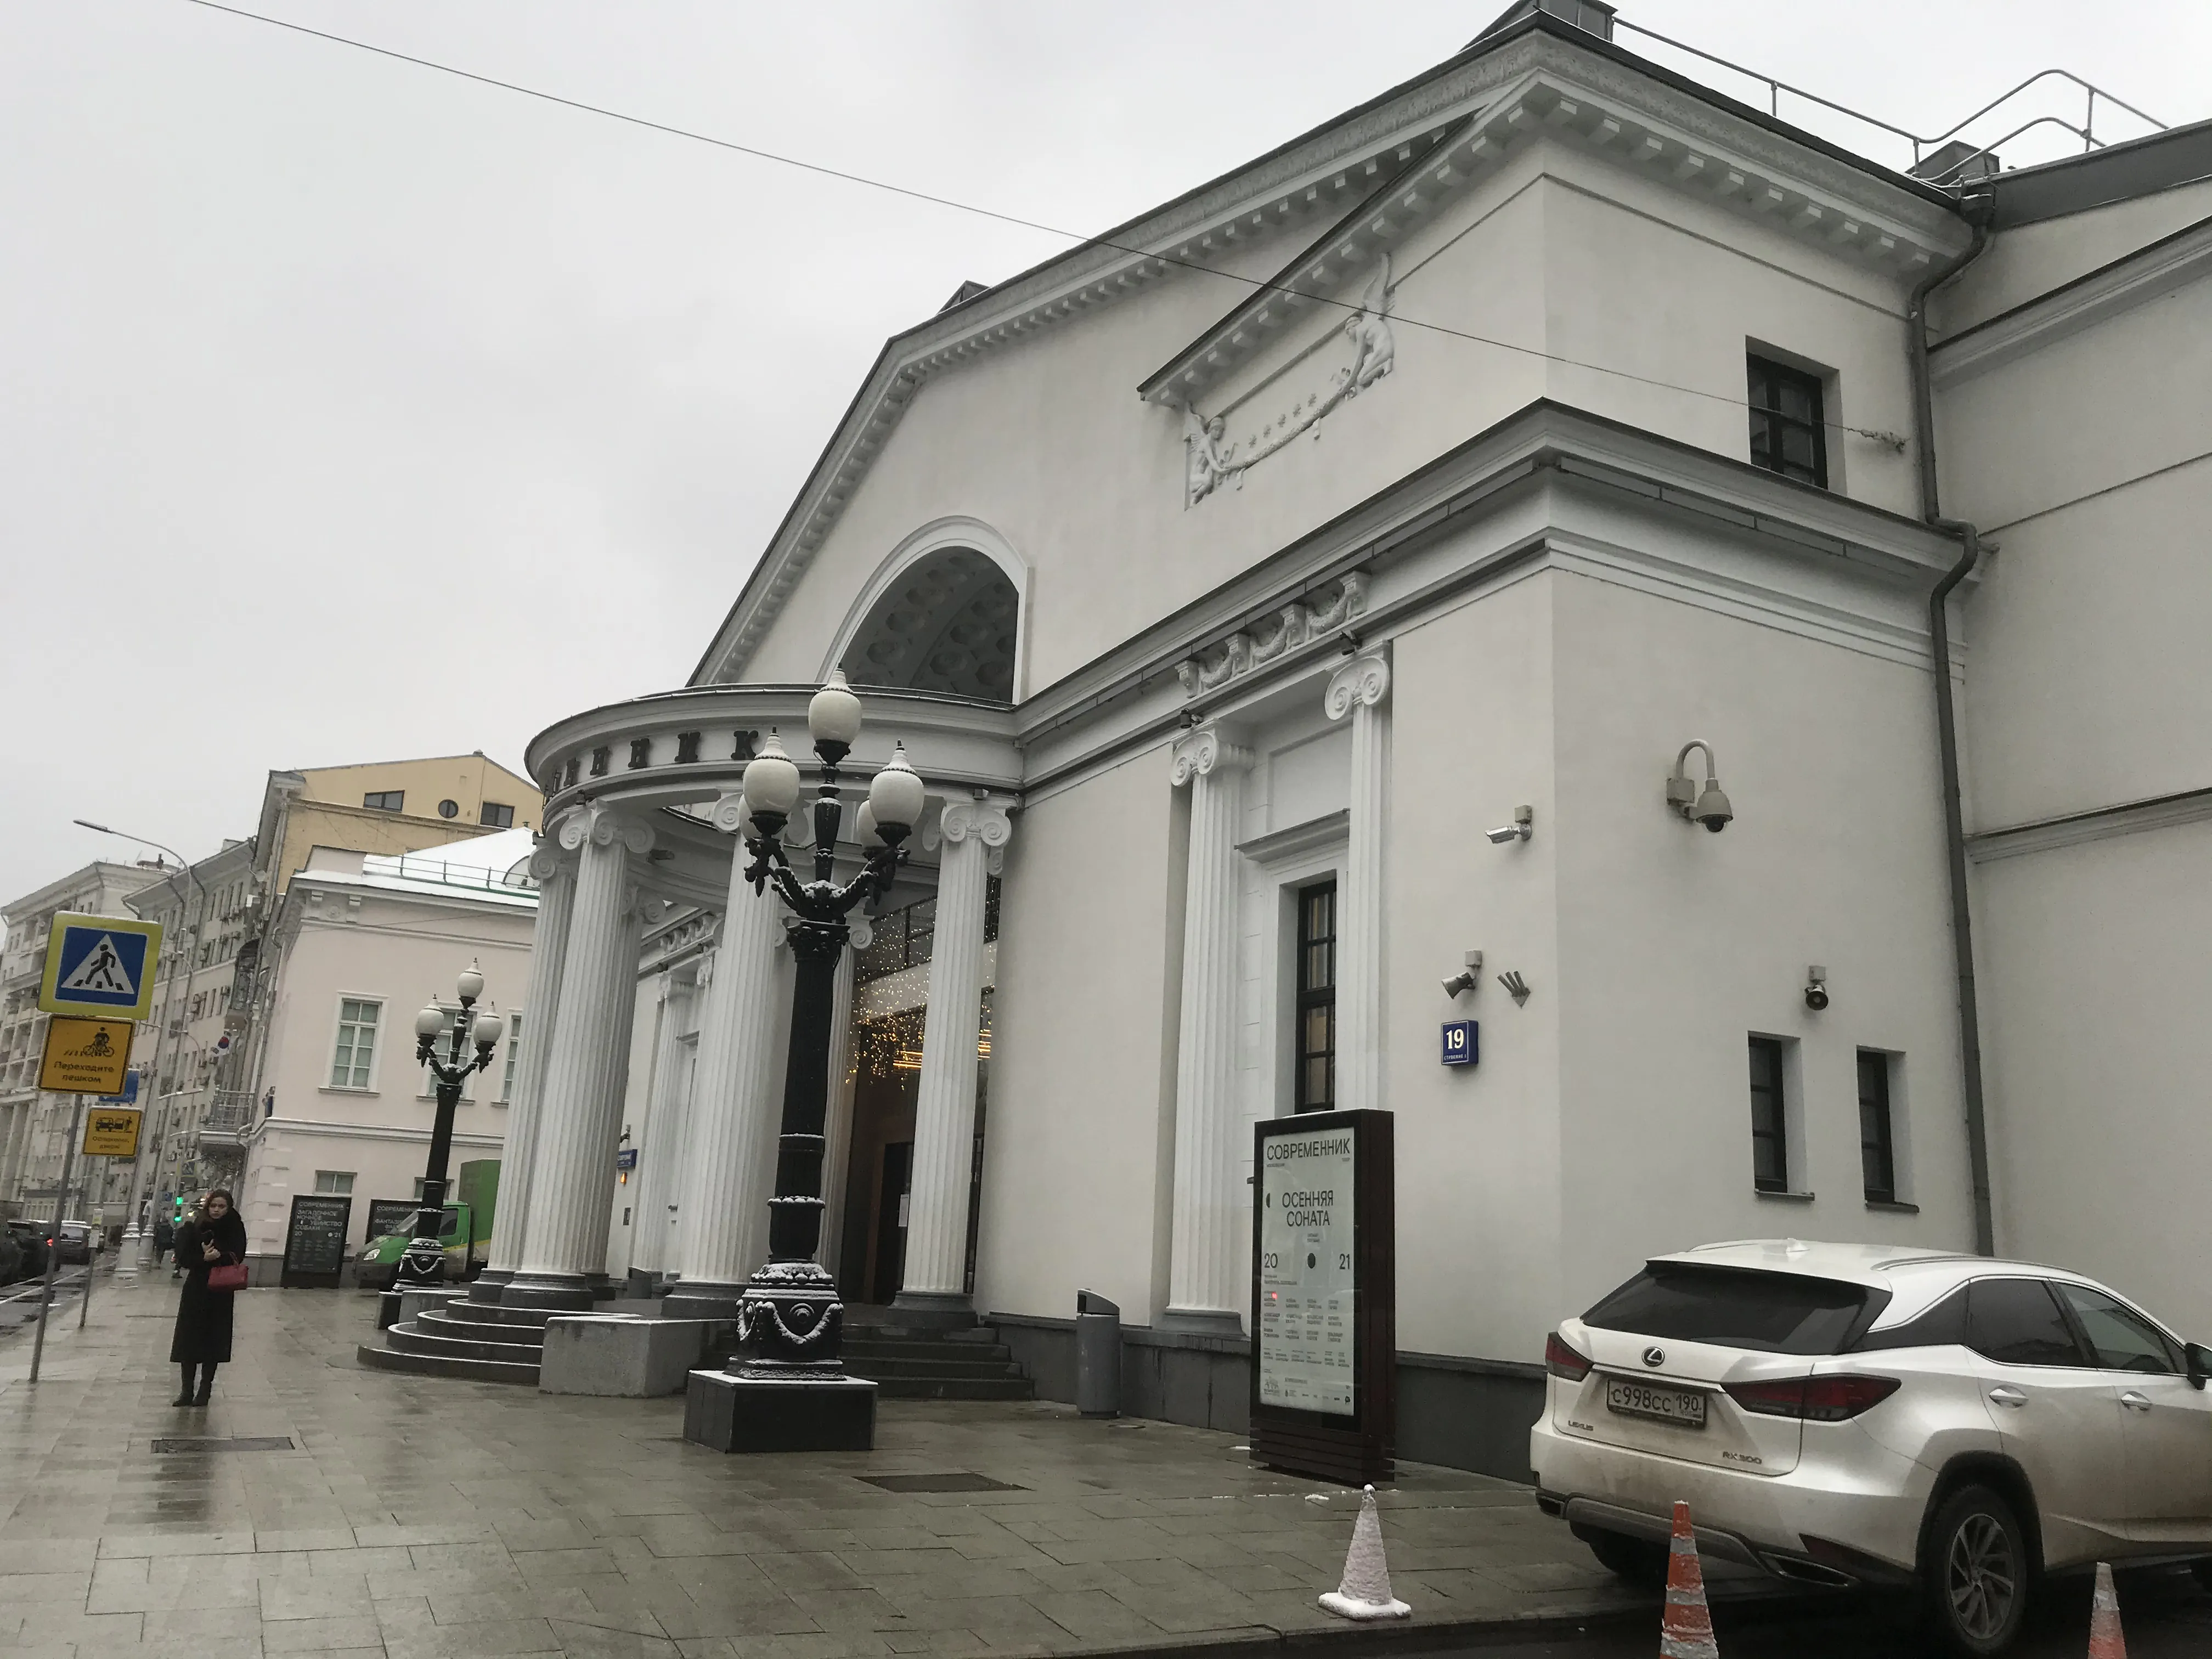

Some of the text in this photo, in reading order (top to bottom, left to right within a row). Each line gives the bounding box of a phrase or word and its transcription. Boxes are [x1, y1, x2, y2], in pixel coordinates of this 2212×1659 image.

[1446, 1029, 1464, 1049] 19
[54, 1060, 114, 1073] Переходите
[62, 1074, 101, 1084] пешком
[1267, 1138, 1350, 1160] СОВРЕМЕННИК
[1282, 1190, 1333, 1208] ОСЕННЯЯ
[1286, 1210, 1330, 1227] СОНАТА
[1264, 1252, 1350, 1270] 20 21
